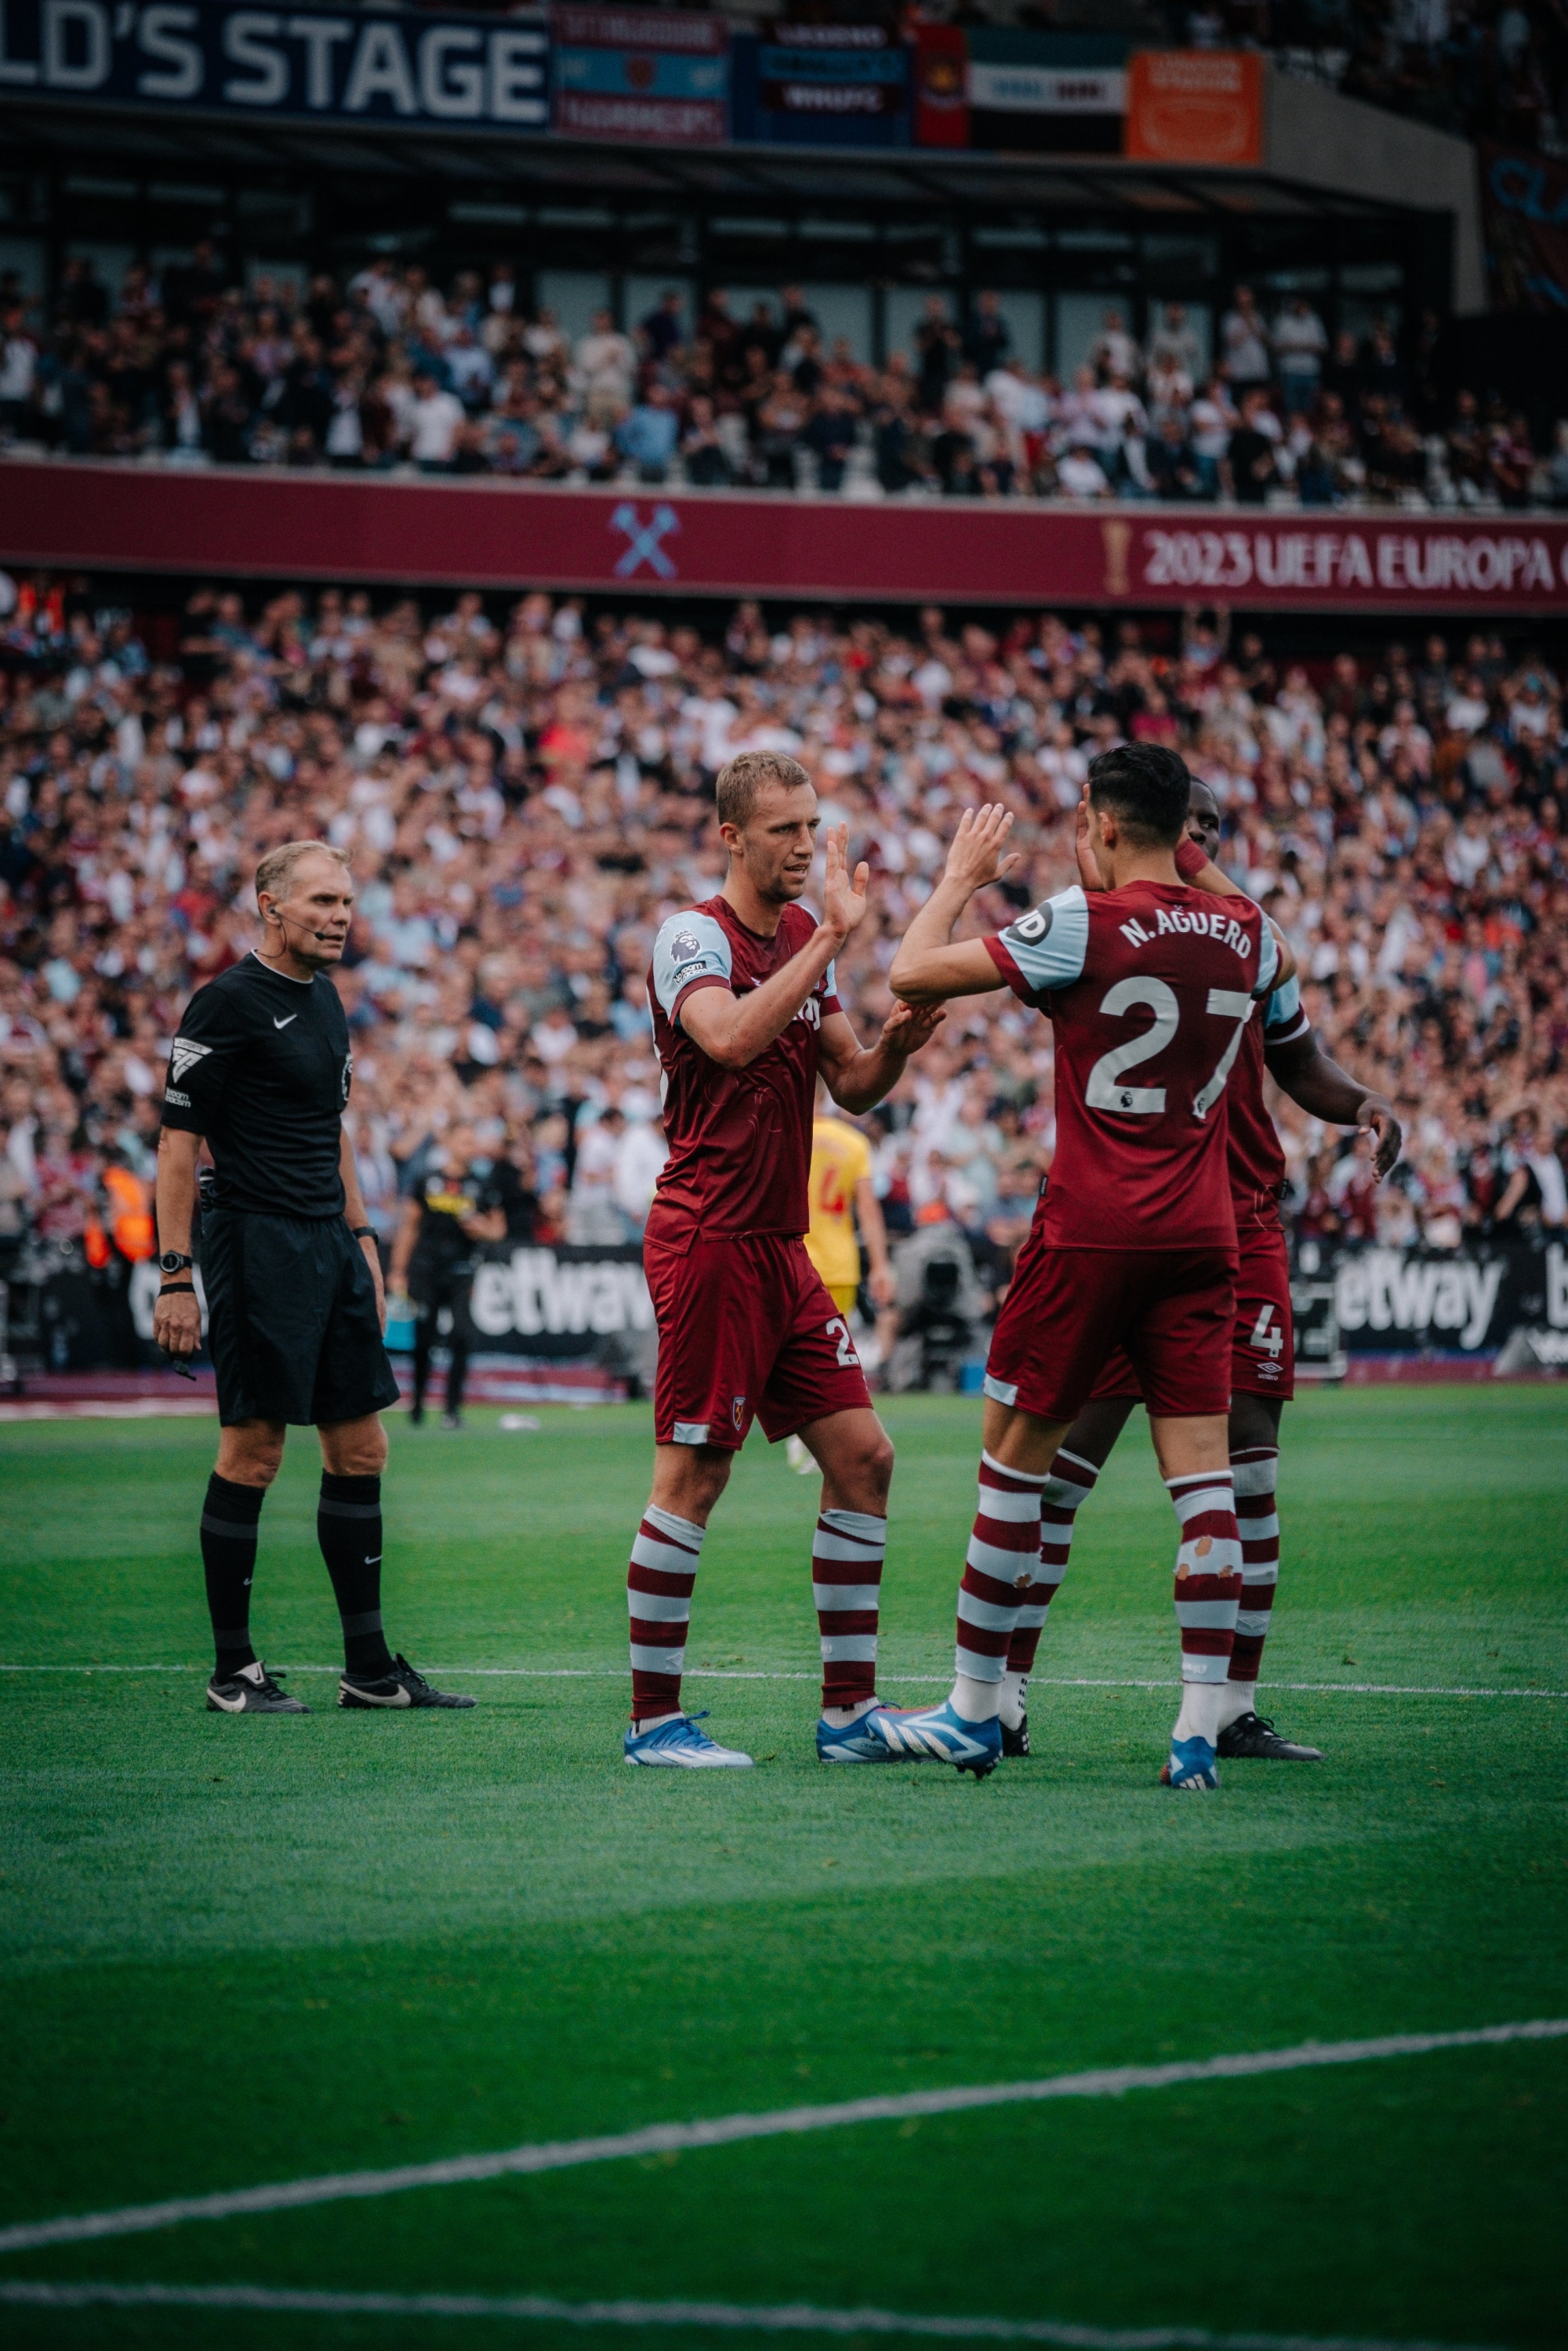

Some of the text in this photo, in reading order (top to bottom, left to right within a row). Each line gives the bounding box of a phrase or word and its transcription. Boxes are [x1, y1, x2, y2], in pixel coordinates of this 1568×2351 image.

[220, 9, 548, 124] STAGE
[1142, 528, 1254, 588] 2023
[1255, 531, 1375, 590] UEFA
[1376, 533, 1557, 593] EUROPA
[1084, 975, 1257, 1119] 27
[468, 1246, 659, 1336] etwa
[1250, 1304, 1284, 1359] 4
[1333, 1243, 1501, 1351] etway
